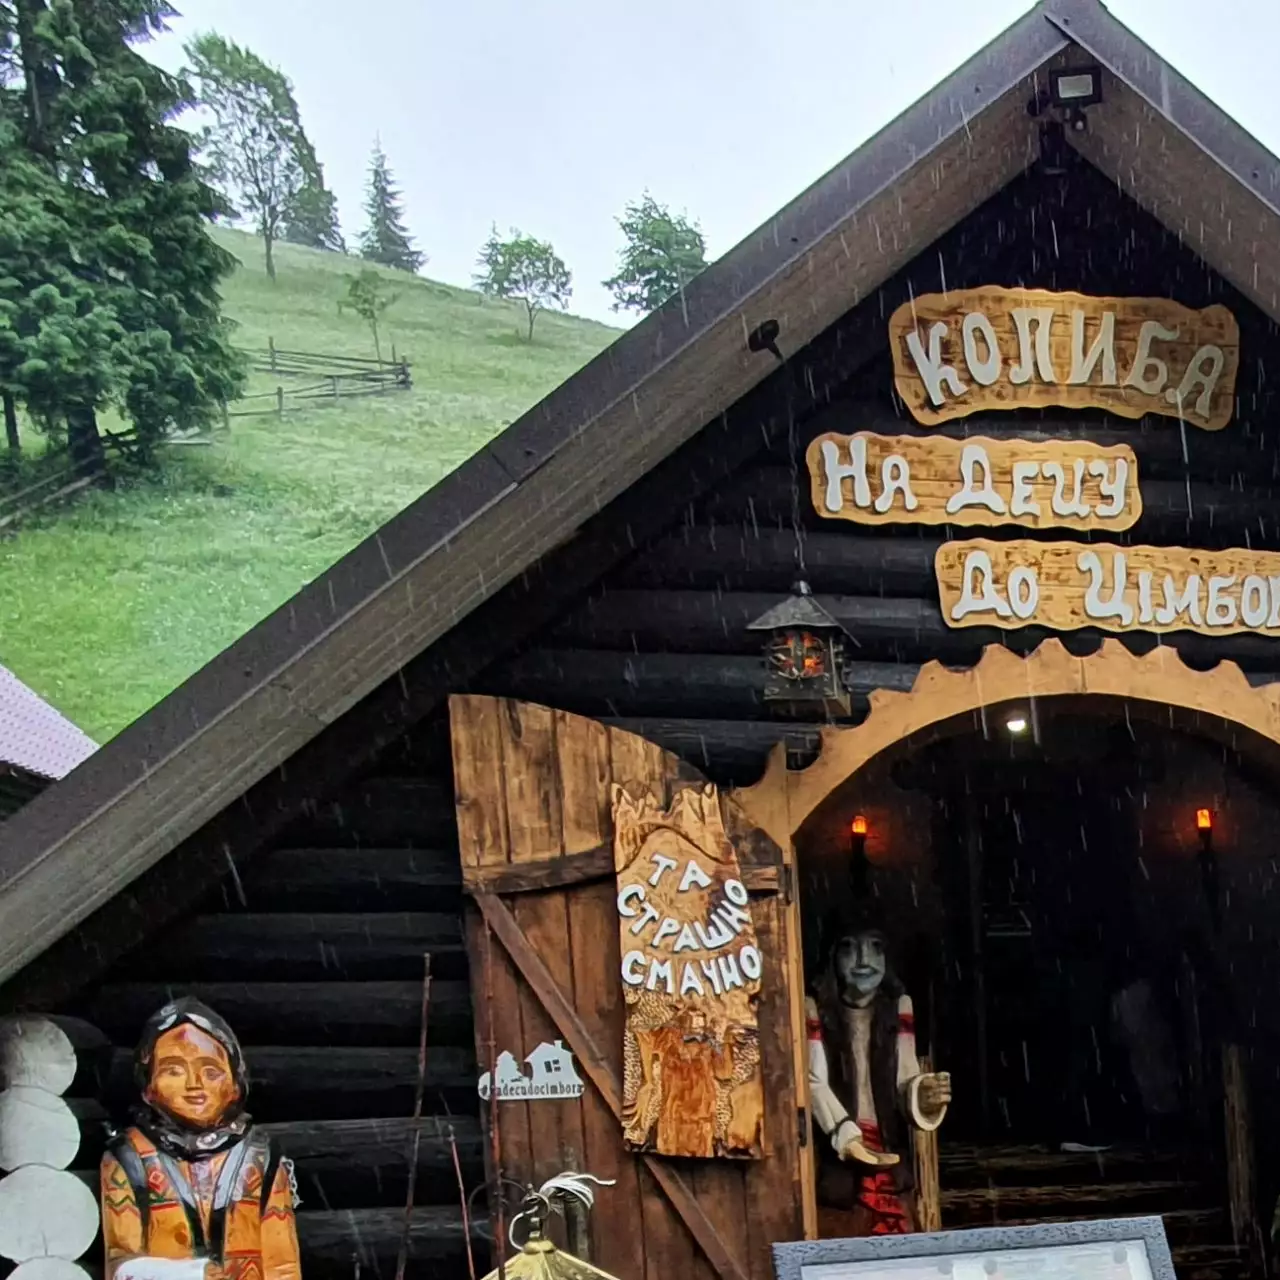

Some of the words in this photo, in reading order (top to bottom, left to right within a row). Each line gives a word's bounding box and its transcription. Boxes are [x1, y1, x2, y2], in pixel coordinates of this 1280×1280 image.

[906, 306, 1225, 418] КОЛИБА
[820, 436, 918, 513] НА
[951, 550, 1040, 620] ДО
[650, 852, 711, 892] ТА
[616, 878, 749, 953] СТРАШНО
[620, 945, 764, 997] СМАЧНО
